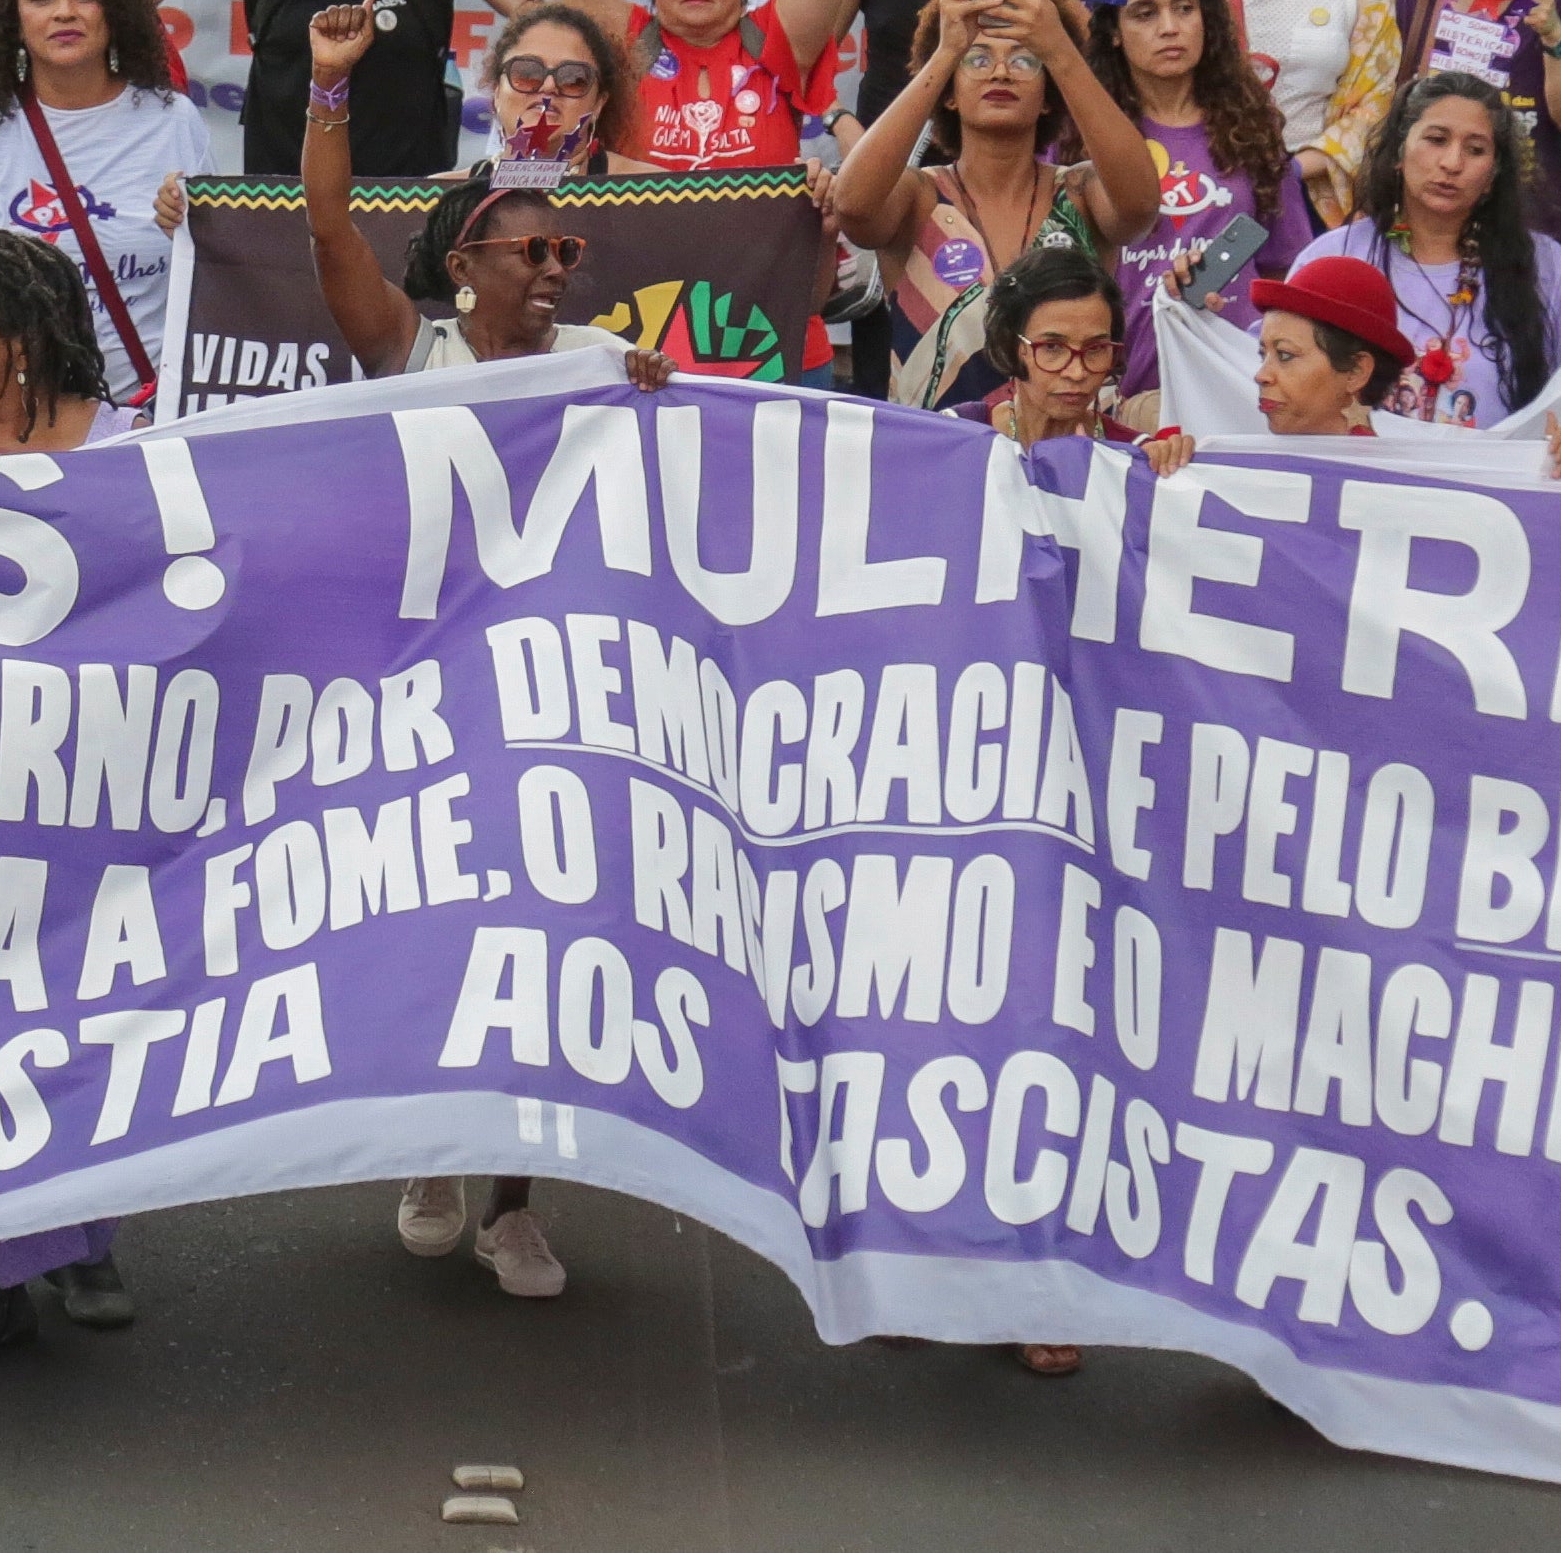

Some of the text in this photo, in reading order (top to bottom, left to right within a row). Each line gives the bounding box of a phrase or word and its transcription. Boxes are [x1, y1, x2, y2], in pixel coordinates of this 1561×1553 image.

[495, 174, 530, 186] NUNCA
[1164, 182, 1193, 207] PT
[192, 332, 330, 391] VIDAS
[243, 668, 453, 821] POR
[485, 613, 1095, 834] DEMOCRACIA
[1108, 709, 1158, 881] E
[1184, 721, 1437, 930] PELO
[75, 863, 167, 1002] A
[203, 772, 514, 978] FOME,
[517, 764, 597, 907] O
[630, 769, 1016, 1032] RACISMO
[1053, 863, 1103, 1038] E
[1112, 912, 1160, 1073] O
[439, 926, 709, 1110] AOS
[775, 1045, 1496, 1353] FASCISTAS.
